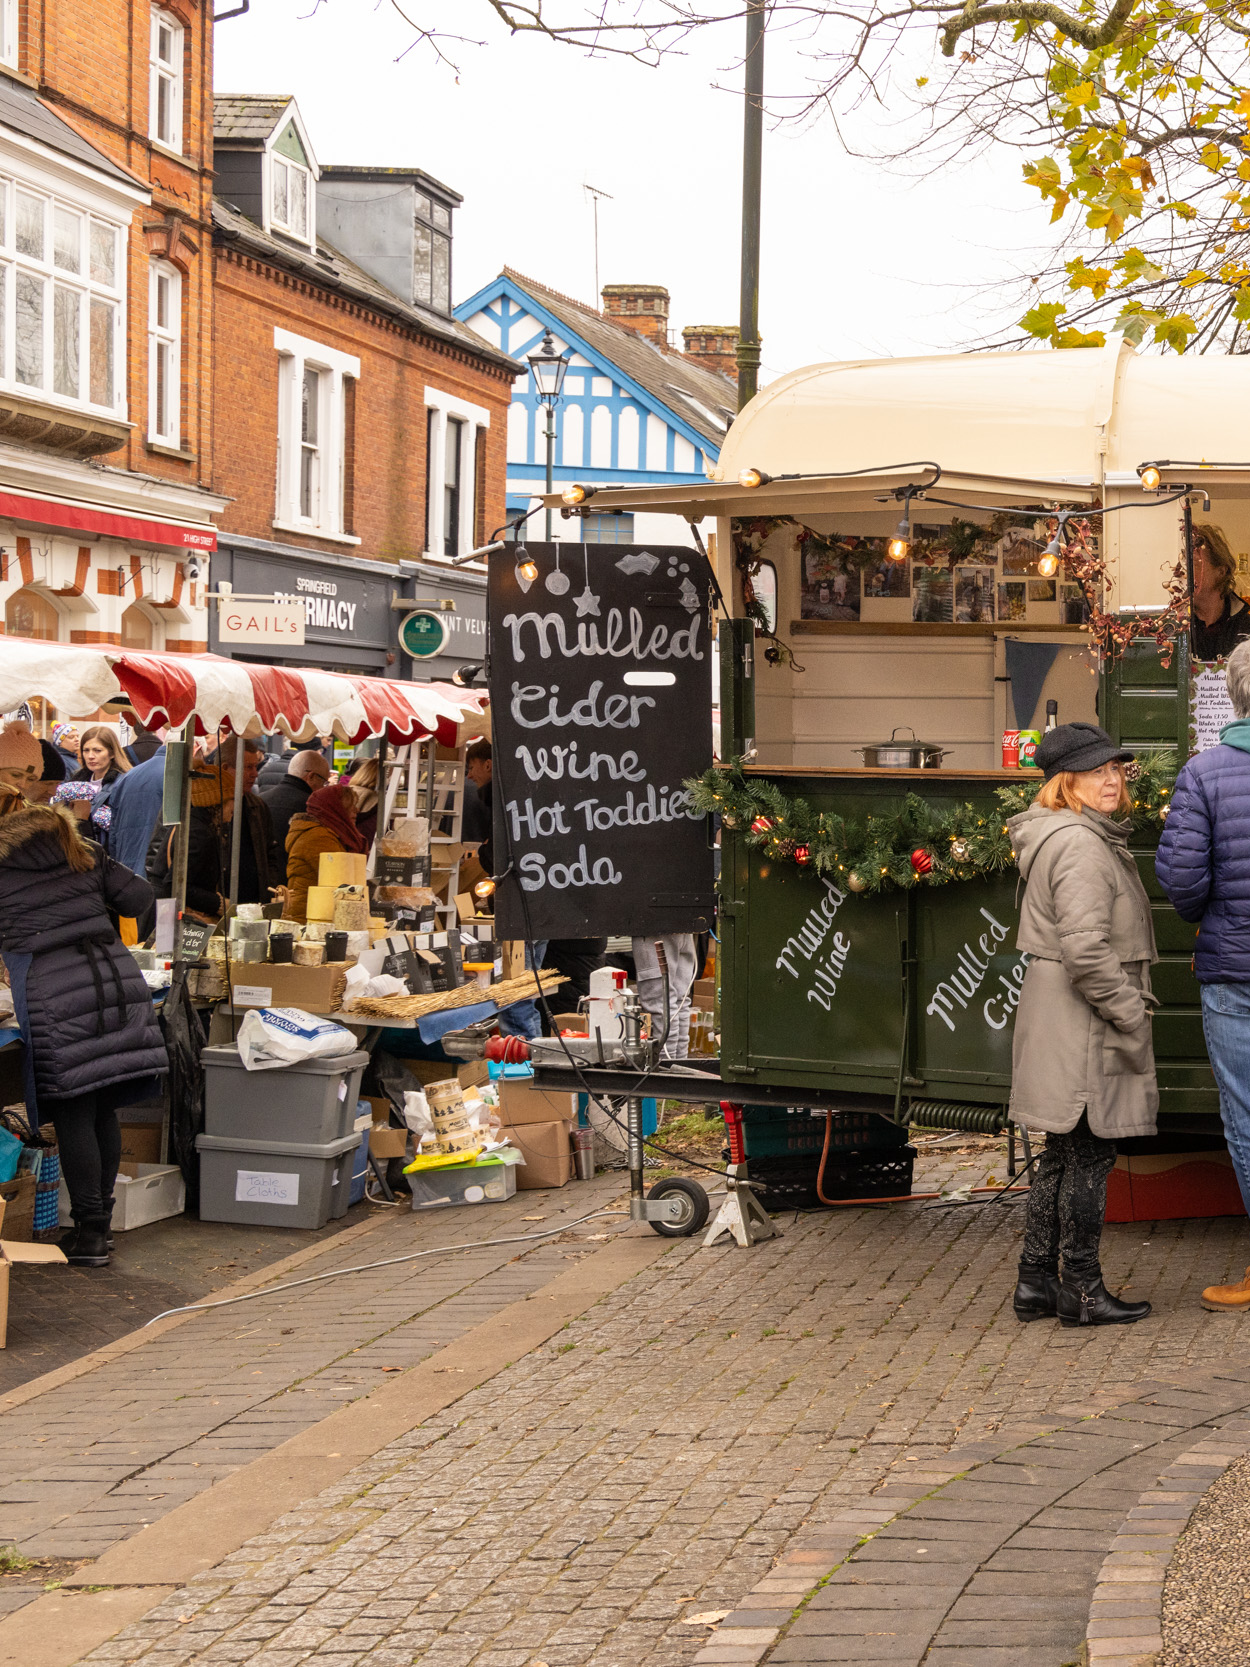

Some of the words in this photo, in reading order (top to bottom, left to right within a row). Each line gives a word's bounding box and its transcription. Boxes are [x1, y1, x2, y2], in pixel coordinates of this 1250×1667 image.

[190, 534, 200, 544] HIGH
[200, 536, 214, 546] STREET
[296, 577, 337, 596] SPRINGFIELD
[226, 614, 298, 632] GAIL's
[465, 618, 487, 634] VELV
[502, 606, 704, 662] Mulled
[511, 680, 656, 728] Cider
[515, 741, 647, 782] Wine
[506, 798, 571, 842] Hot
[520, 844, 622, 892] Soda
[776, 876, 848, 980] Mulled
[807, 930, 851, 1011] Wine
[926, 906, 1010, 1032] Mulled
[246, 1176, 279, 1186] Table
[247, 1187, 287, 1198] Cloths
